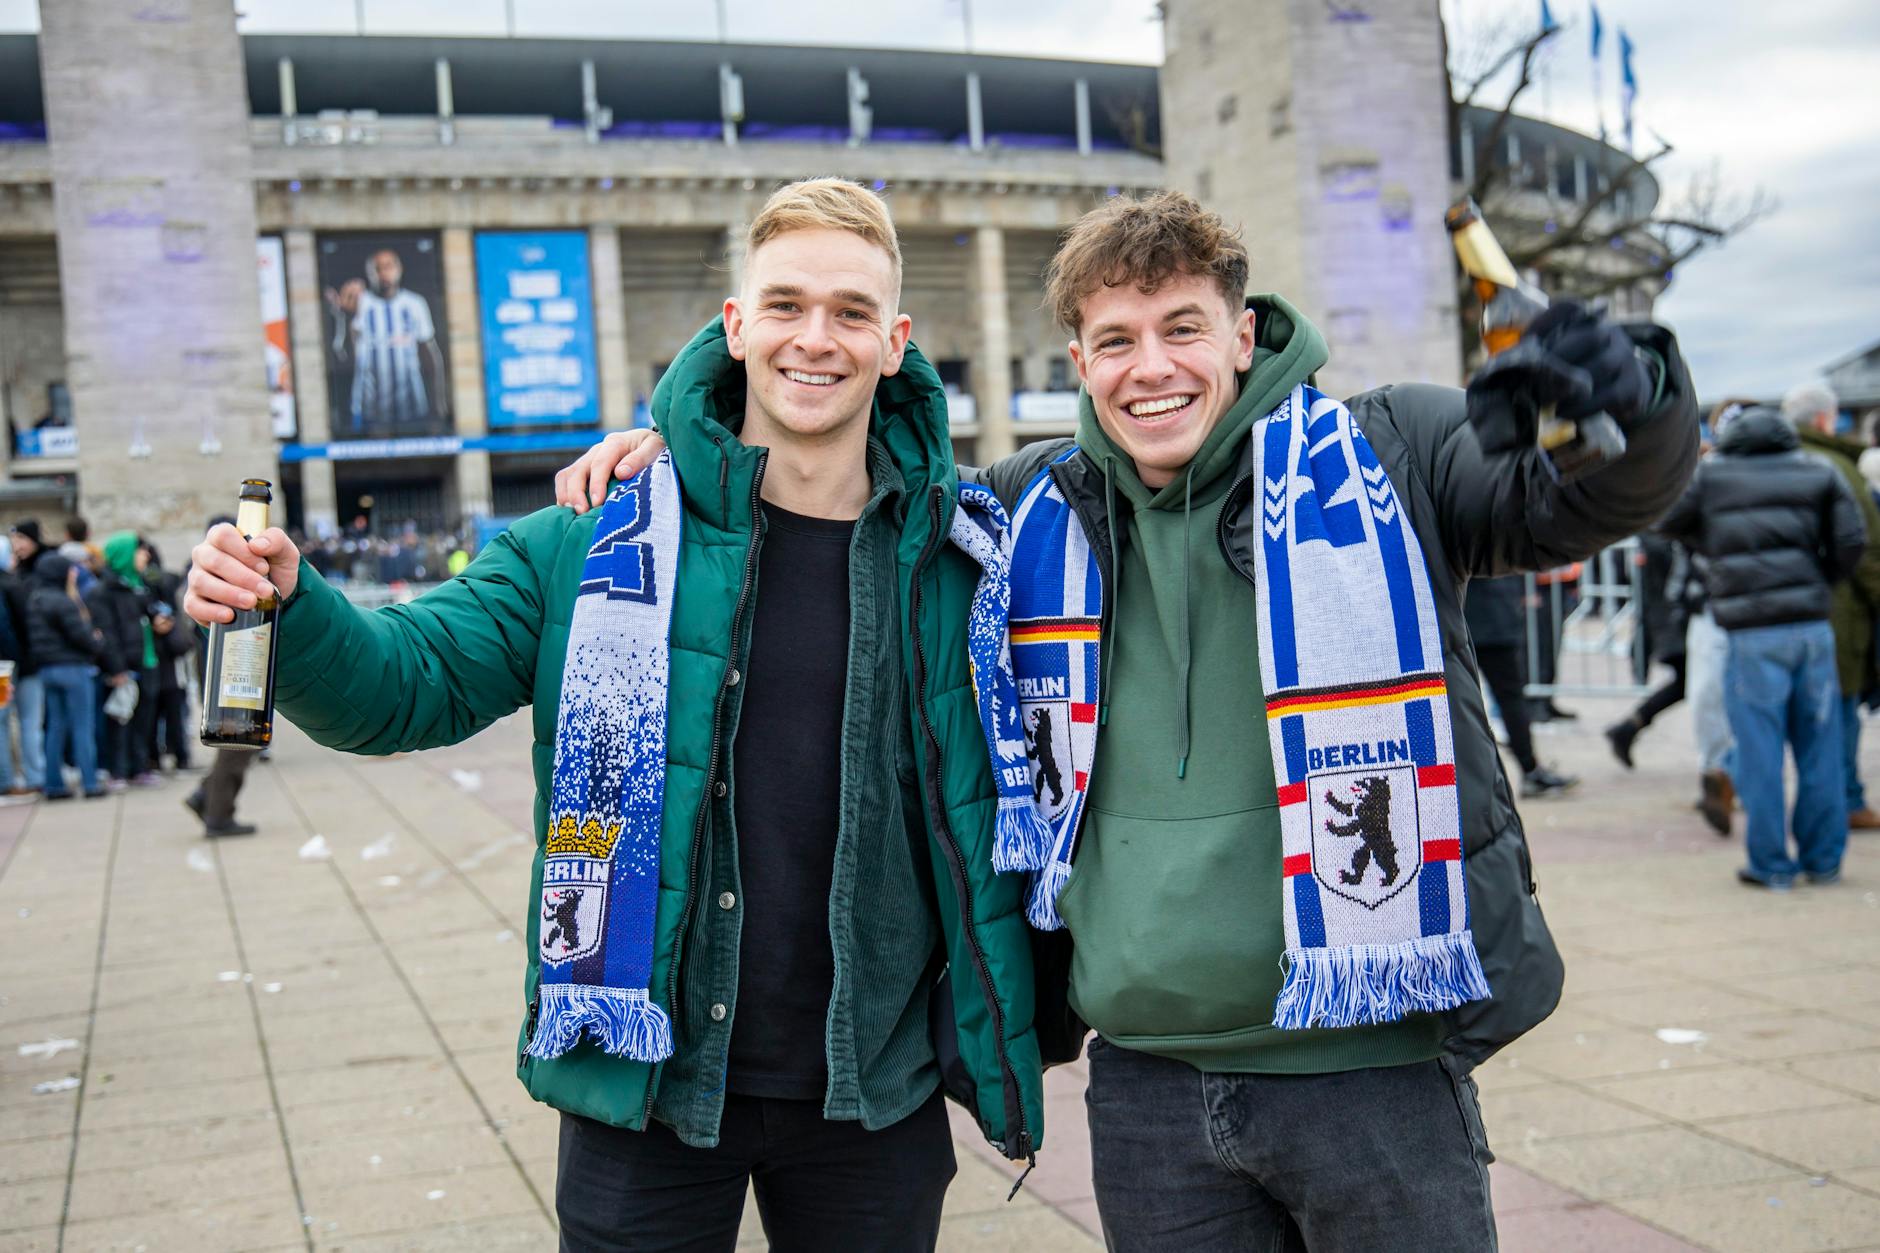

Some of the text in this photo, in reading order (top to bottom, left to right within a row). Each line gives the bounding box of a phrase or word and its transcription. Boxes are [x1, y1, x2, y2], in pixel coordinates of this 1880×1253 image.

[1019, 676, 1066, 698] ERLIN
[1308, 738, 1410, 771] BERLIN
[546, 860, 610, 882] ERLIN
